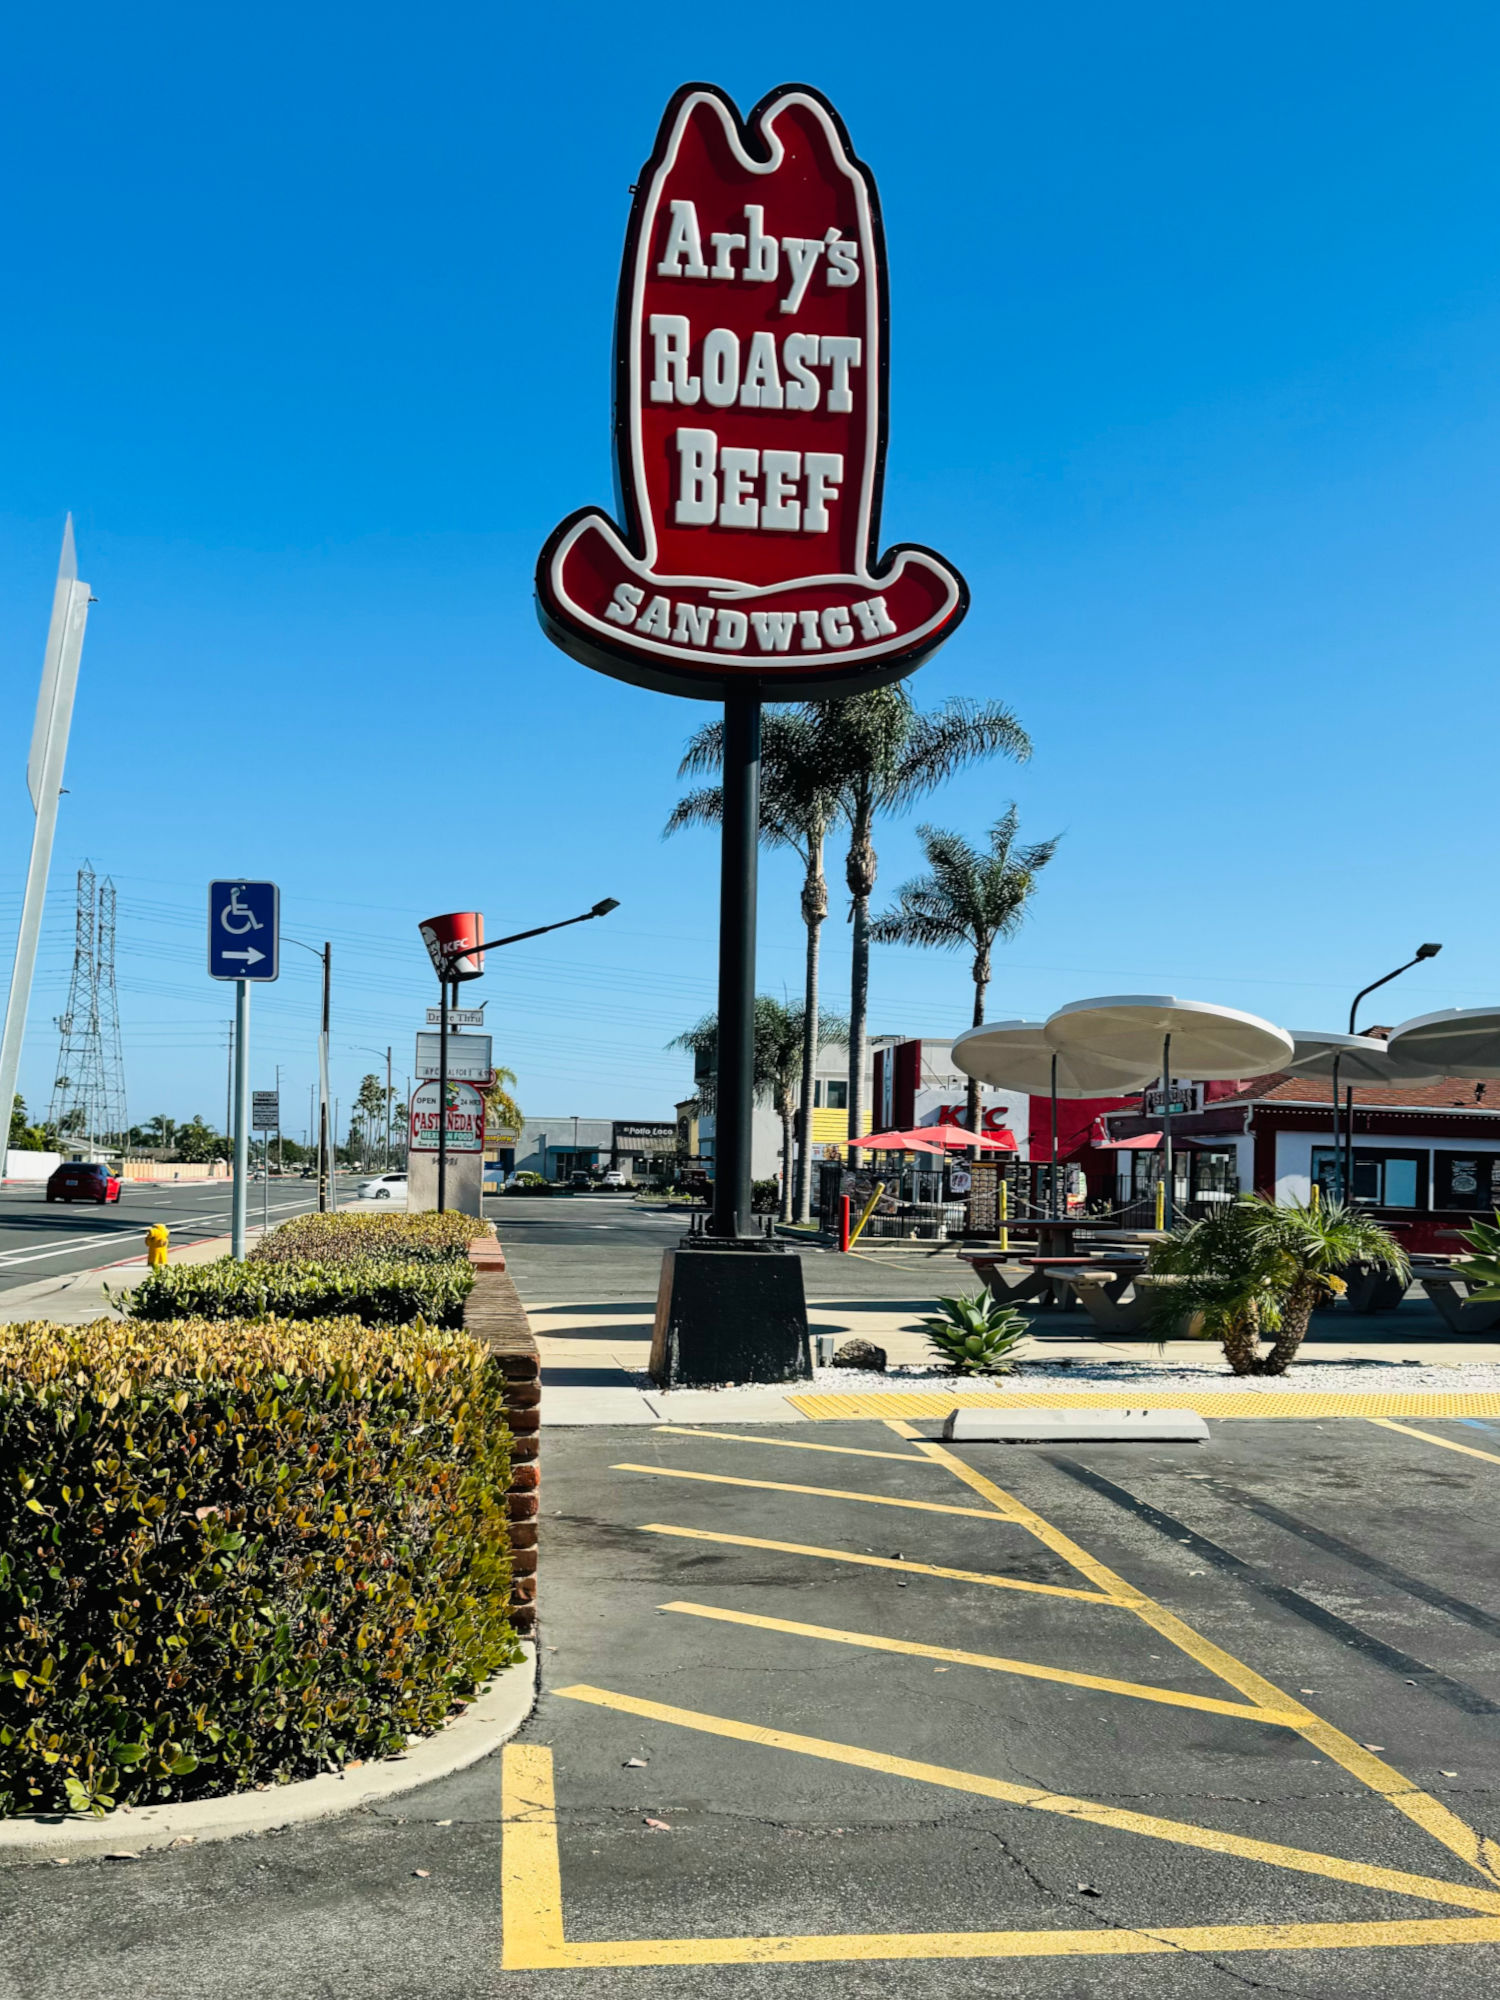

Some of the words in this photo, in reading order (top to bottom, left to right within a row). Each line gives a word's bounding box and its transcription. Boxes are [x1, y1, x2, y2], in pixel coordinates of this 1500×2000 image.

[657, 199, 860, 314] Arby's
[649, 313, 861, 413] ROAST
[675, 427, 844, 533] BEEF
[603, 582, 897, 652] SANDWICH
[443, 937, 469, 954] KFC
[428, 1013, 455, 1022] Dre
[416, 1097, 437, 1105] OPEN
[938, 1105, 1009, 1129] KC
